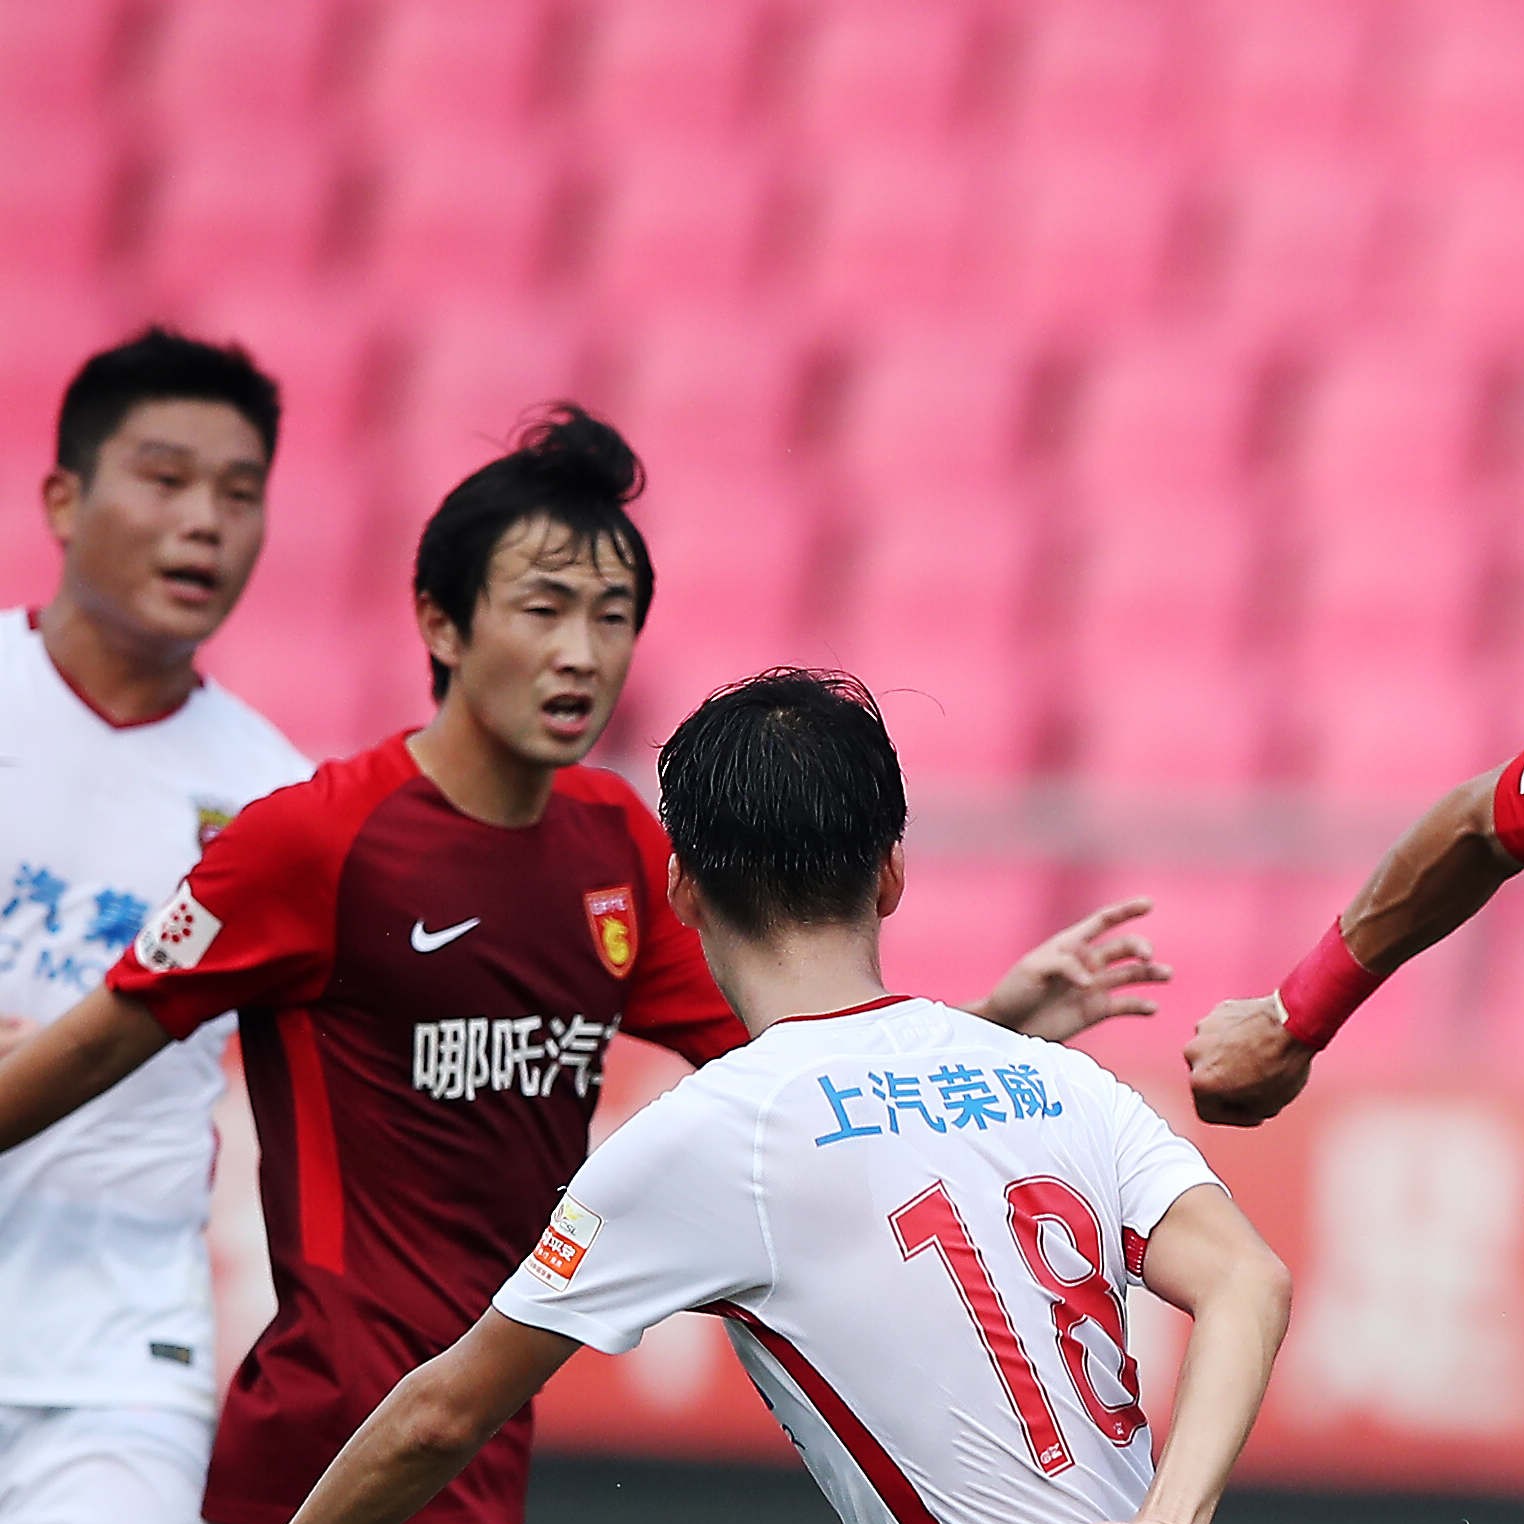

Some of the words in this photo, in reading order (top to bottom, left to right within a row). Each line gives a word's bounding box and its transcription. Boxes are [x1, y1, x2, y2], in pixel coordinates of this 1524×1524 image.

[412, 1013, 622, 1101] 哪吒汽
[814, 1064, 1062, 1147] 上汽荣威
[887, 1174, 1147, 1478] 18
